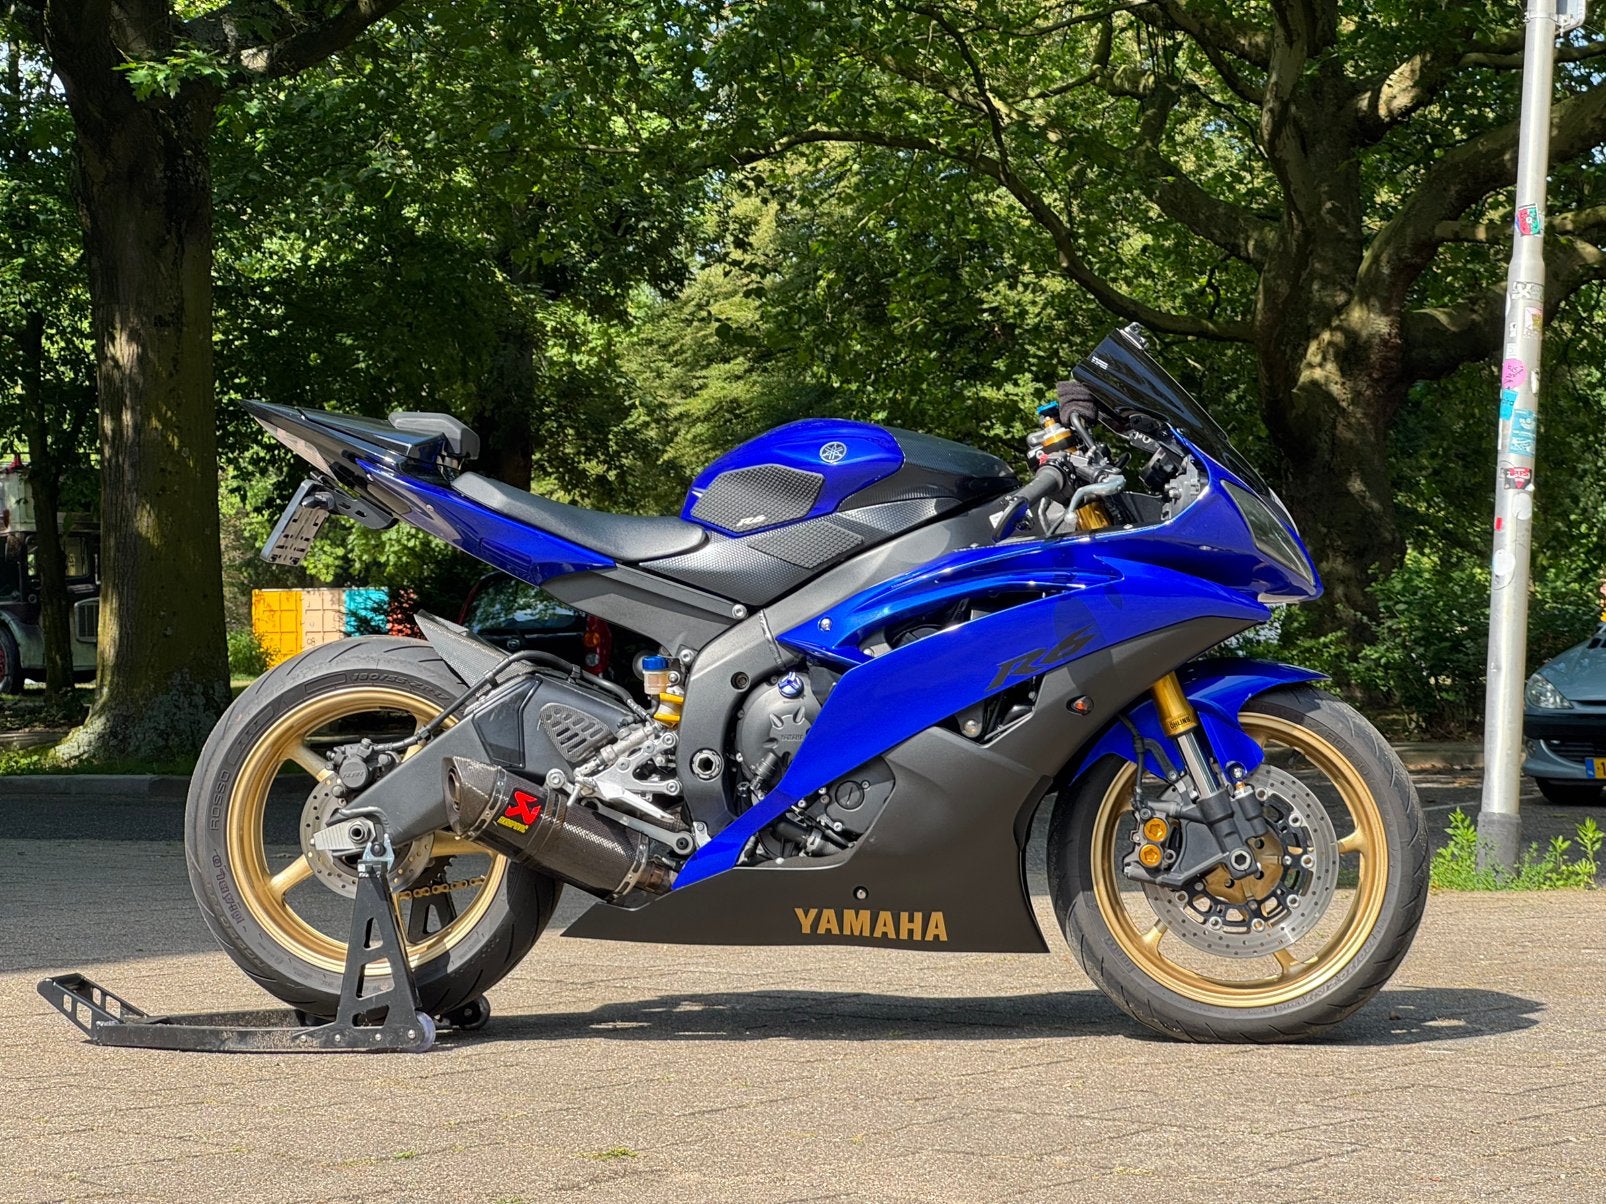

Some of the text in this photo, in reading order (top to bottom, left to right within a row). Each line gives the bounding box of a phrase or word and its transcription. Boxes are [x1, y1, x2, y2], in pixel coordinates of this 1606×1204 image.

[984, 623, 1096, 692] R6
[209, 770, 230, 832] ROSSO
[794, 908, 948, 942] YAMAHA
